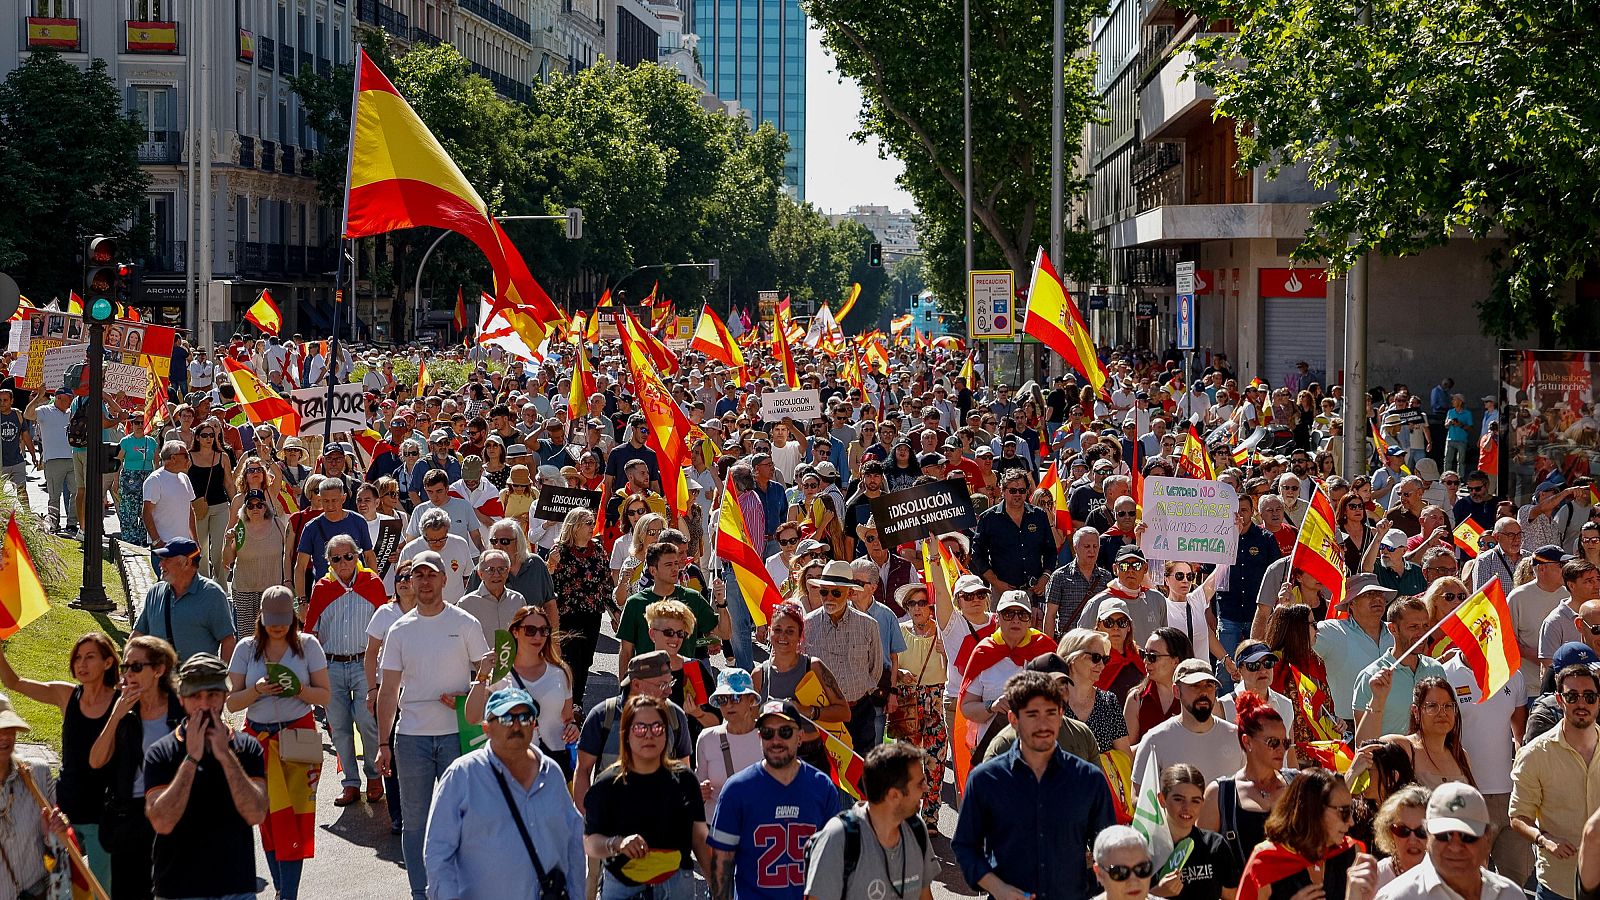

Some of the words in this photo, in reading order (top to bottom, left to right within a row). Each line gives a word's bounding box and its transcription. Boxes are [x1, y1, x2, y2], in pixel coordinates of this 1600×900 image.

[1542, 373, 1559, 381] Dale
[888, 491, 953, 519] ¡DISOLUCIÓN
[884, 527, 891, 535] DE
[891, 525, 897, 533] LA
[897, 516, 920, 531] MAFIA
[920, 505, 966, 525] SANCHISTA!!
[500, 641, 511, 671] VOX
[278, 672, 294, 690] VOX
[775, 805, 800, 817] GIANTS
[753, 823, 817, 888] 25
